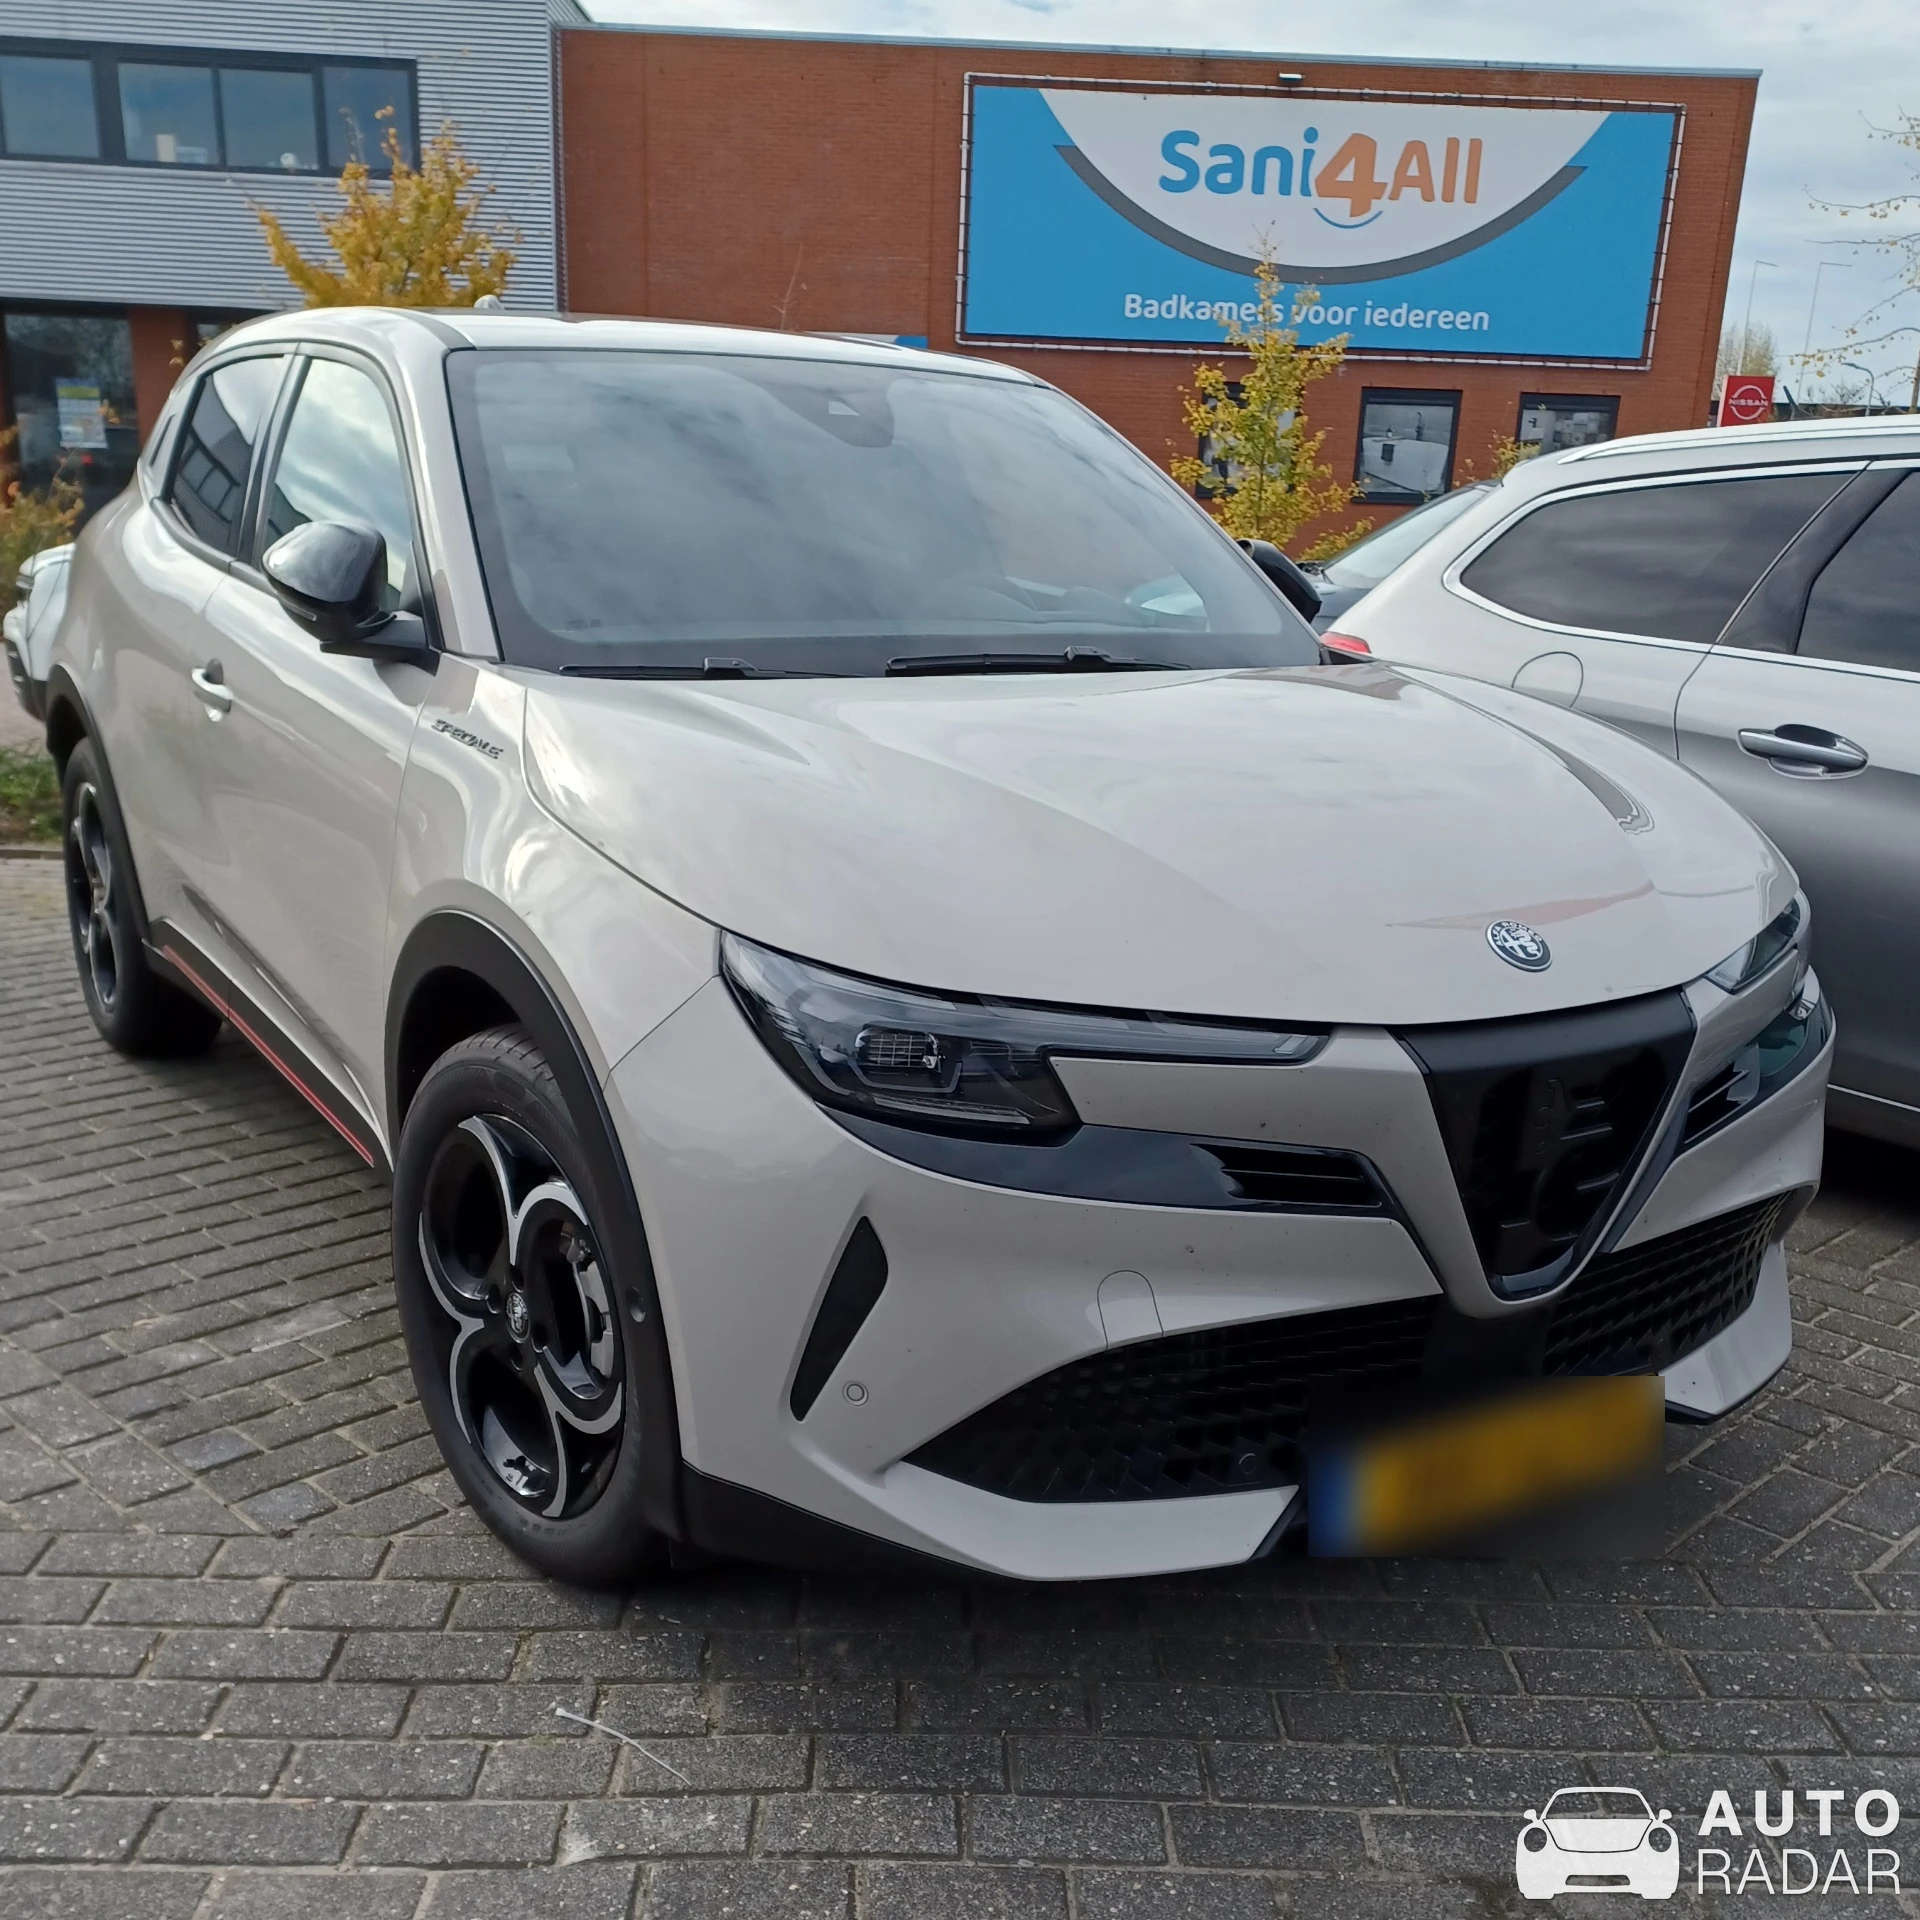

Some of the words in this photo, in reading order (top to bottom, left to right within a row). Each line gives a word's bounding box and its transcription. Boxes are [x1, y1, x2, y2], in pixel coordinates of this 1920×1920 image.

[1158, 126, 1483, 218] Sani4All
[1124, 293, 1285, 324] Badkames
[1291, 303, 1358, 326] voor
[1364, 300, 1490, 331] iedereen
[1728, 398, 1769, 406] NISSAN
